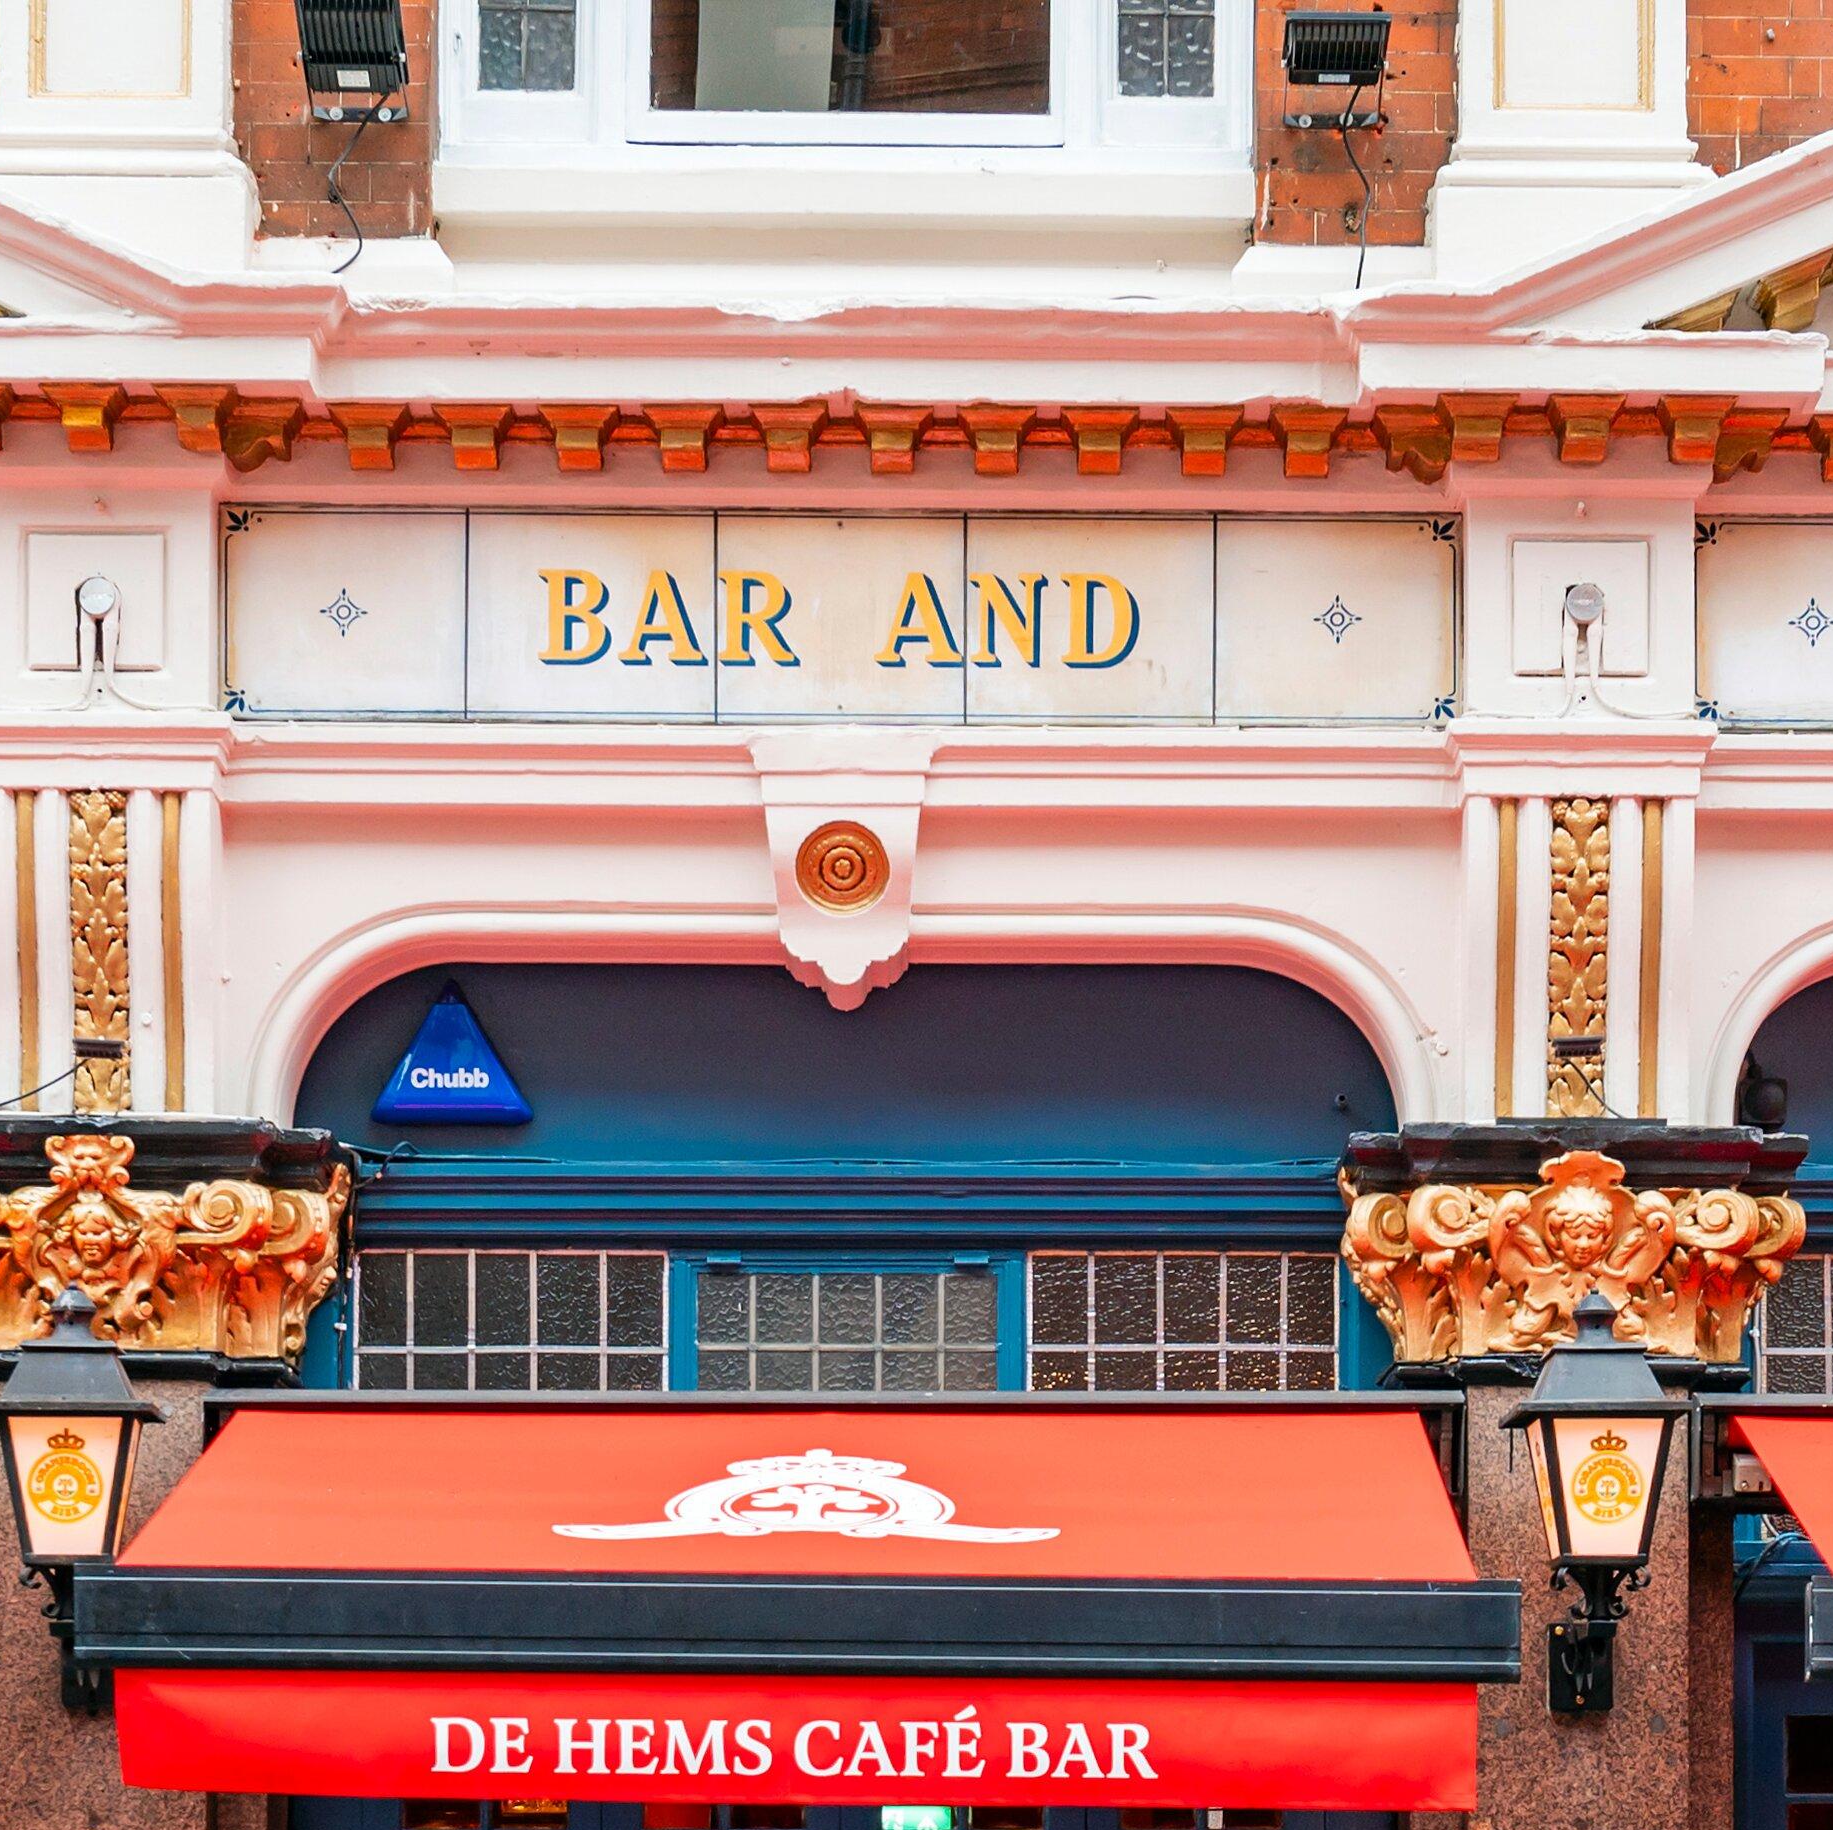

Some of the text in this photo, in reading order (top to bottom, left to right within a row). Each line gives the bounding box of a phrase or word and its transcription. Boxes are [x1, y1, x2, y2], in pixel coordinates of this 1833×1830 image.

[538, 567, 1141, 669] BAR AND
[410, 1067, 490, 1088] Chubb
[430, 1704, 1159, 1779] DE HEMS CAFÉ BAR
